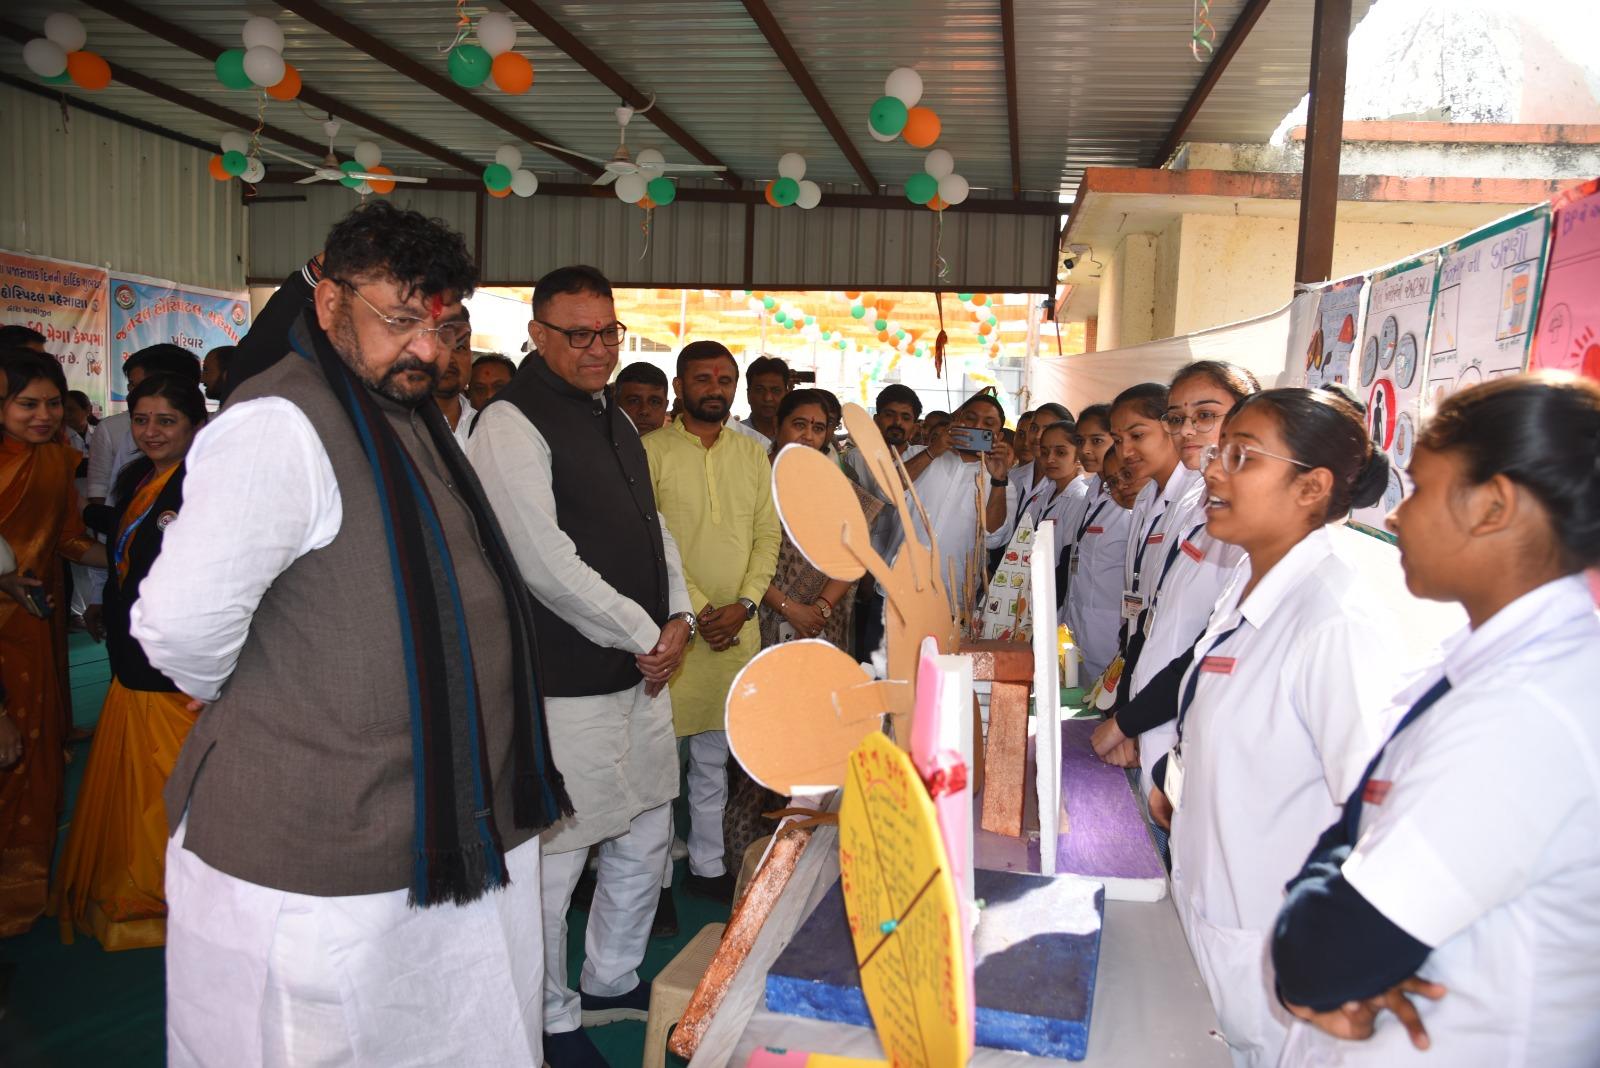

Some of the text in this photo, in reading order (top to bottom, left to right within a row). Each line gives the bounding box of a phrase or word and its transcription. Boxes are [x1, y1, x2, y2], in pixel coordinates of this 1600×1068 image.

[1, 284, 45, 304] હોસ્પિટલ
[48, 291, 88, 309] મહેસાણા
[47, 323, 70, 343] મેગા
[171, 332, 204, 349] પરિવાર
